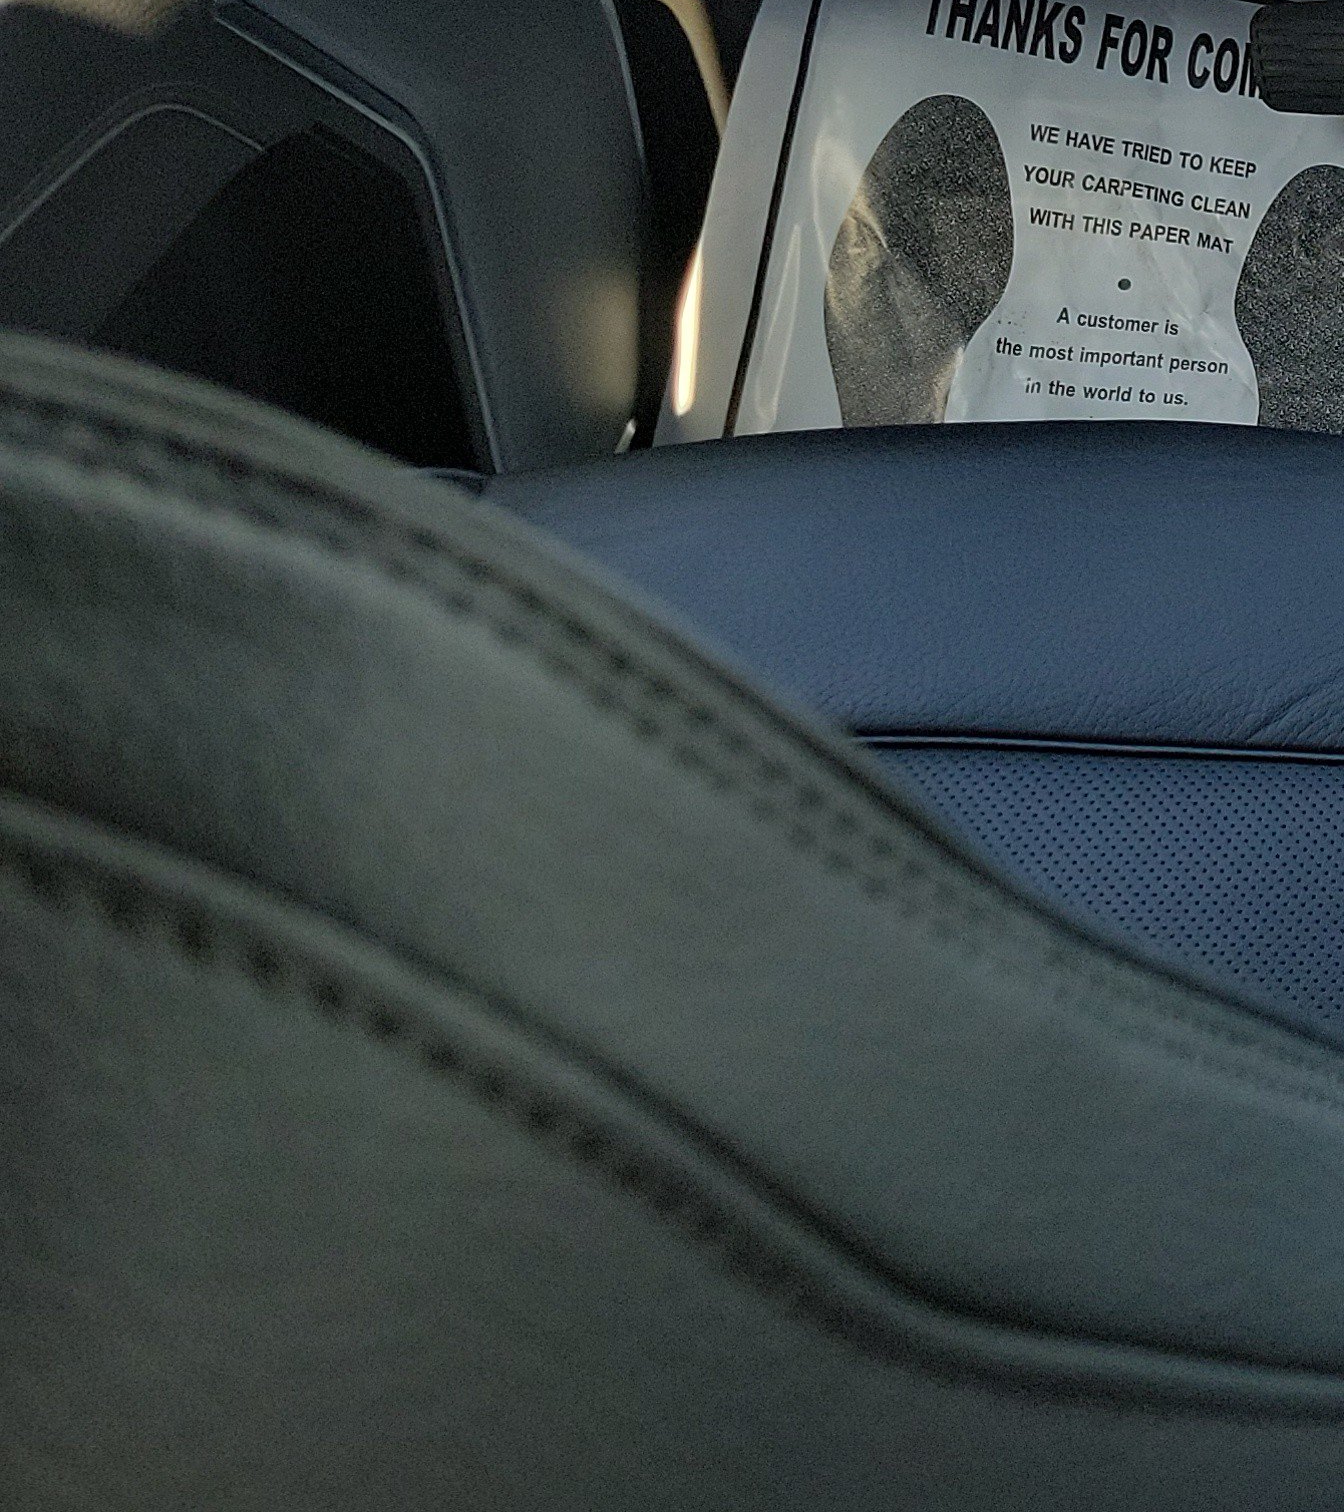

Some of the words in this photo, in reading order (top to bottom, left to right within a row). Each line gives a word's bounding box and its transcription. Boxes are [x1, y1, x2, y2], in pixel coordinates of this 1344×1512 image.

[1096, 13, 1174, 84] FOR
[1030, 123, 1060, 144] WE
[1065, 129, 1115, 154] HAVE
[1121, 140, 1172, 165] TRIED
[1179, 151, 1203, 171] TO
[1209, 156, 1257, 179] KEEP
[1023, 164, 1075, 188] YOUR
[1081, 174, 1185, 207] CARPETING
[1190, 195, 1251, 219] CLEAN
[1029, 207, 1075, 230] WITH
[1082, 215, 1123, 236] THIS
[1129, 222, 1190, 246] PAPER
[1196, 232, 1234, 254] MAT
[1056, 307, 1070, 324] A
[1076, 313, 1159, 333] customer
[1164, 319, 1179, 336] is
[996, 337, 1022, 356] the
[1028, 345, 1074, 362] most
[1079, 347, 1163, 369] important
[1168, 356, 1229, 375] person
[1025, 377, 1041, 394] in
[1048, 379, 1076, 397] the
[1082, 385, 1132, 402] world
[1138, 388, 1156, 403] to
[1163, 391, 1189, 406] us.
